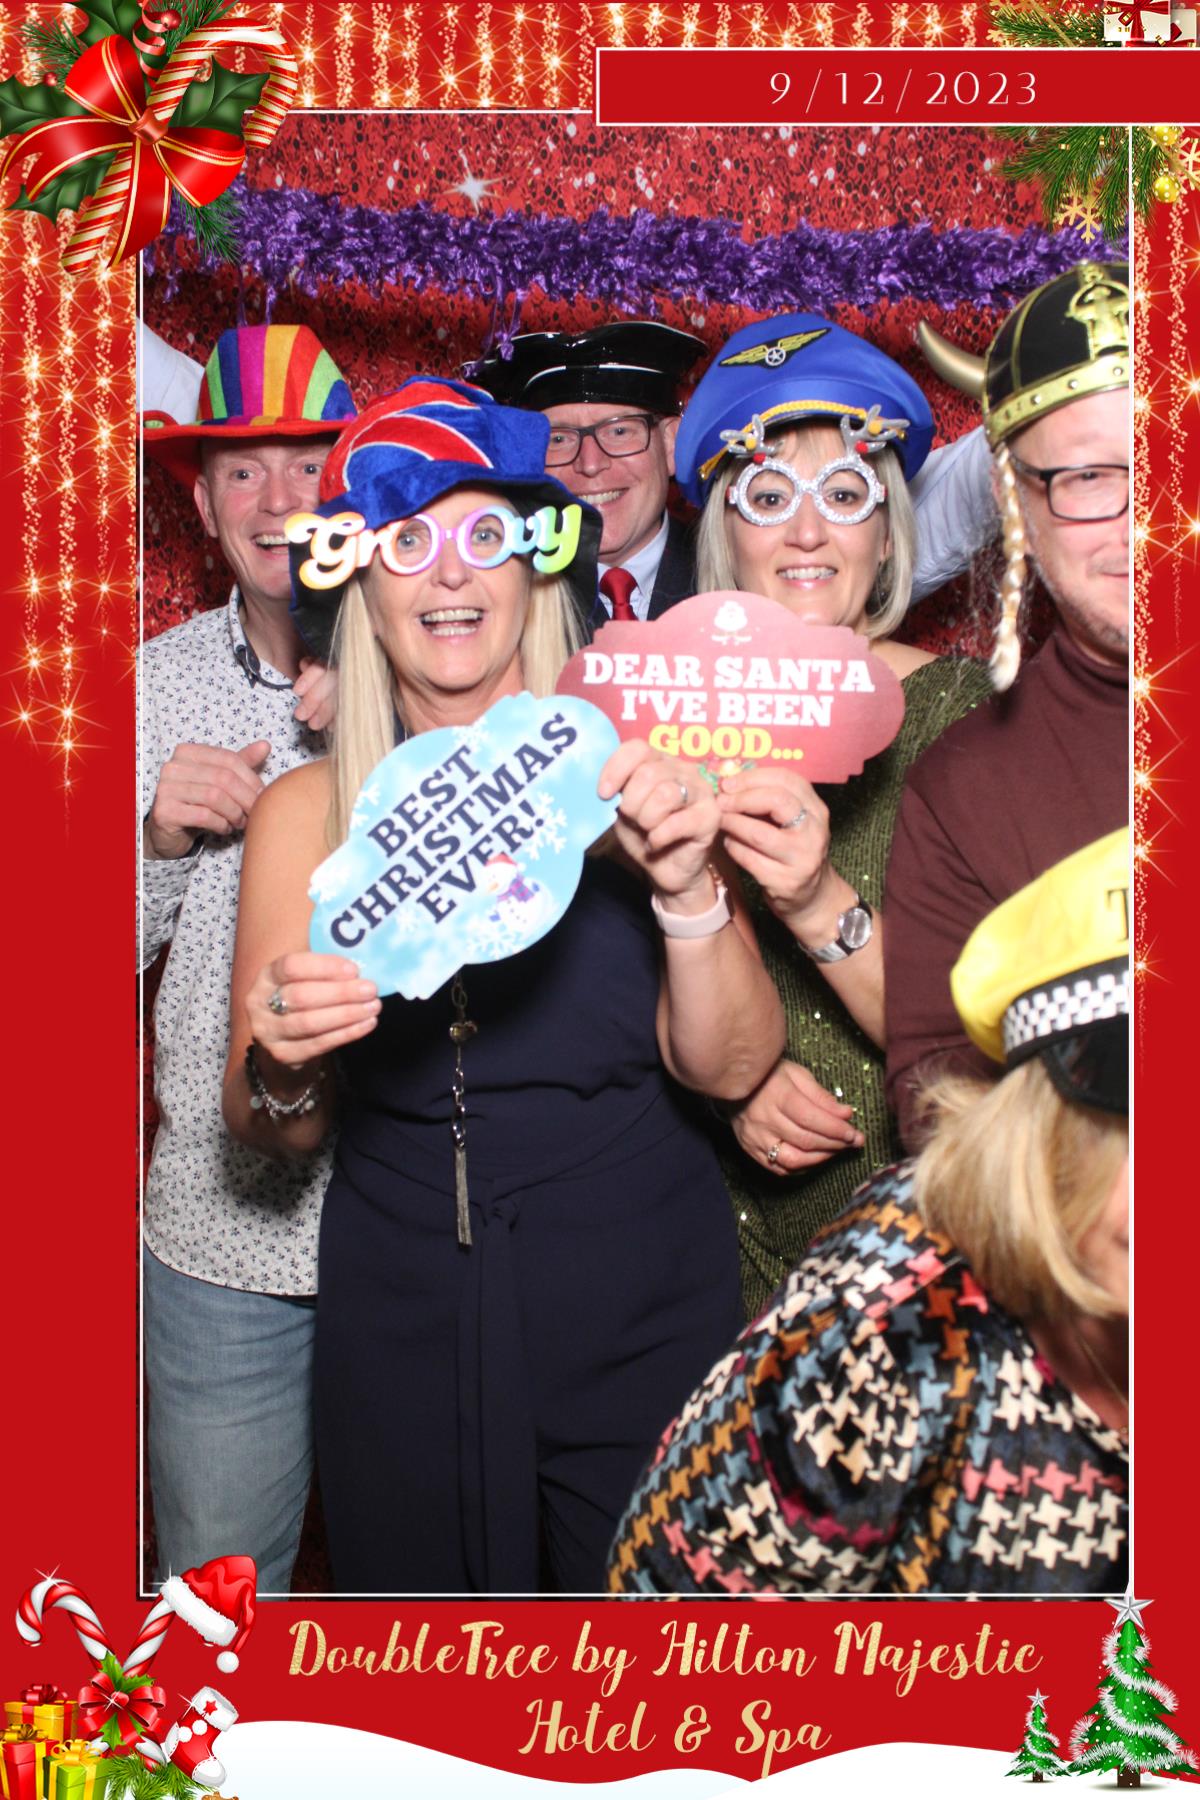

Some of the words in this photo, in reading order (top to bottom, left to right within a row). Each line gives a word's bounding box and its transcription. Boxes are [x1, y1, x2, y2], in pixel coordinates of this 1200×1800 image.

[583, 652, 703, 688] DEAR
[714, 655, 875, 692] SANTA
[621, 688, 708, 725] I'VE
[718, 692, 833, 728] BEEN
[648, 724, 804, 761] GOOD...
[329, 713, 579, 949] CHRISTMAS
[367, 744, 484, 858] BEST
[415, 800, 546, 924] EVER!
